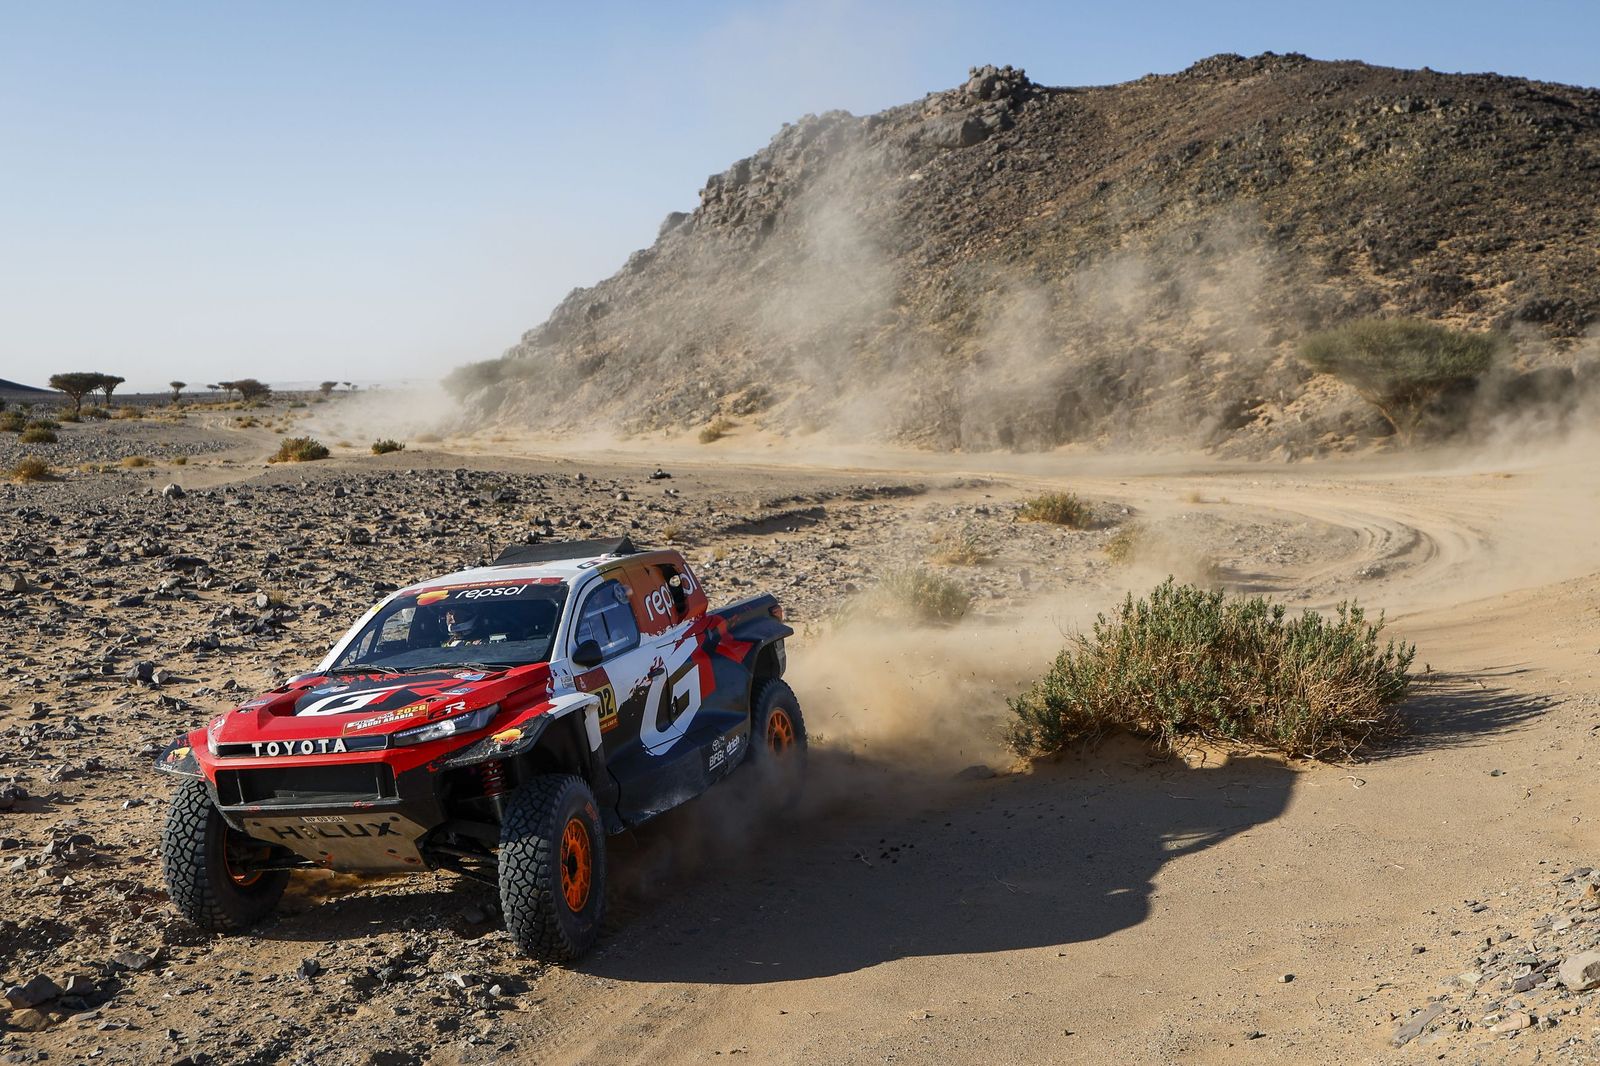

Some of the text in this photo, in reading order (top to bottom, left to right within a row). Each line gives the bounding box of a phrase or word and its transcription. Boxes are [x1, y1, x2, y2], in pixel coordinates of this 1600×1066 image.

[455, 584, 528, 600] repsol
[644, 563, 698, 622] repol
[396, 704, 426, 716] 2026
[357, 719, 382, 730] SAUDI
[383, 712, 414, 723] ARABIA
[251, 738, 347, 757] TOYOTA
